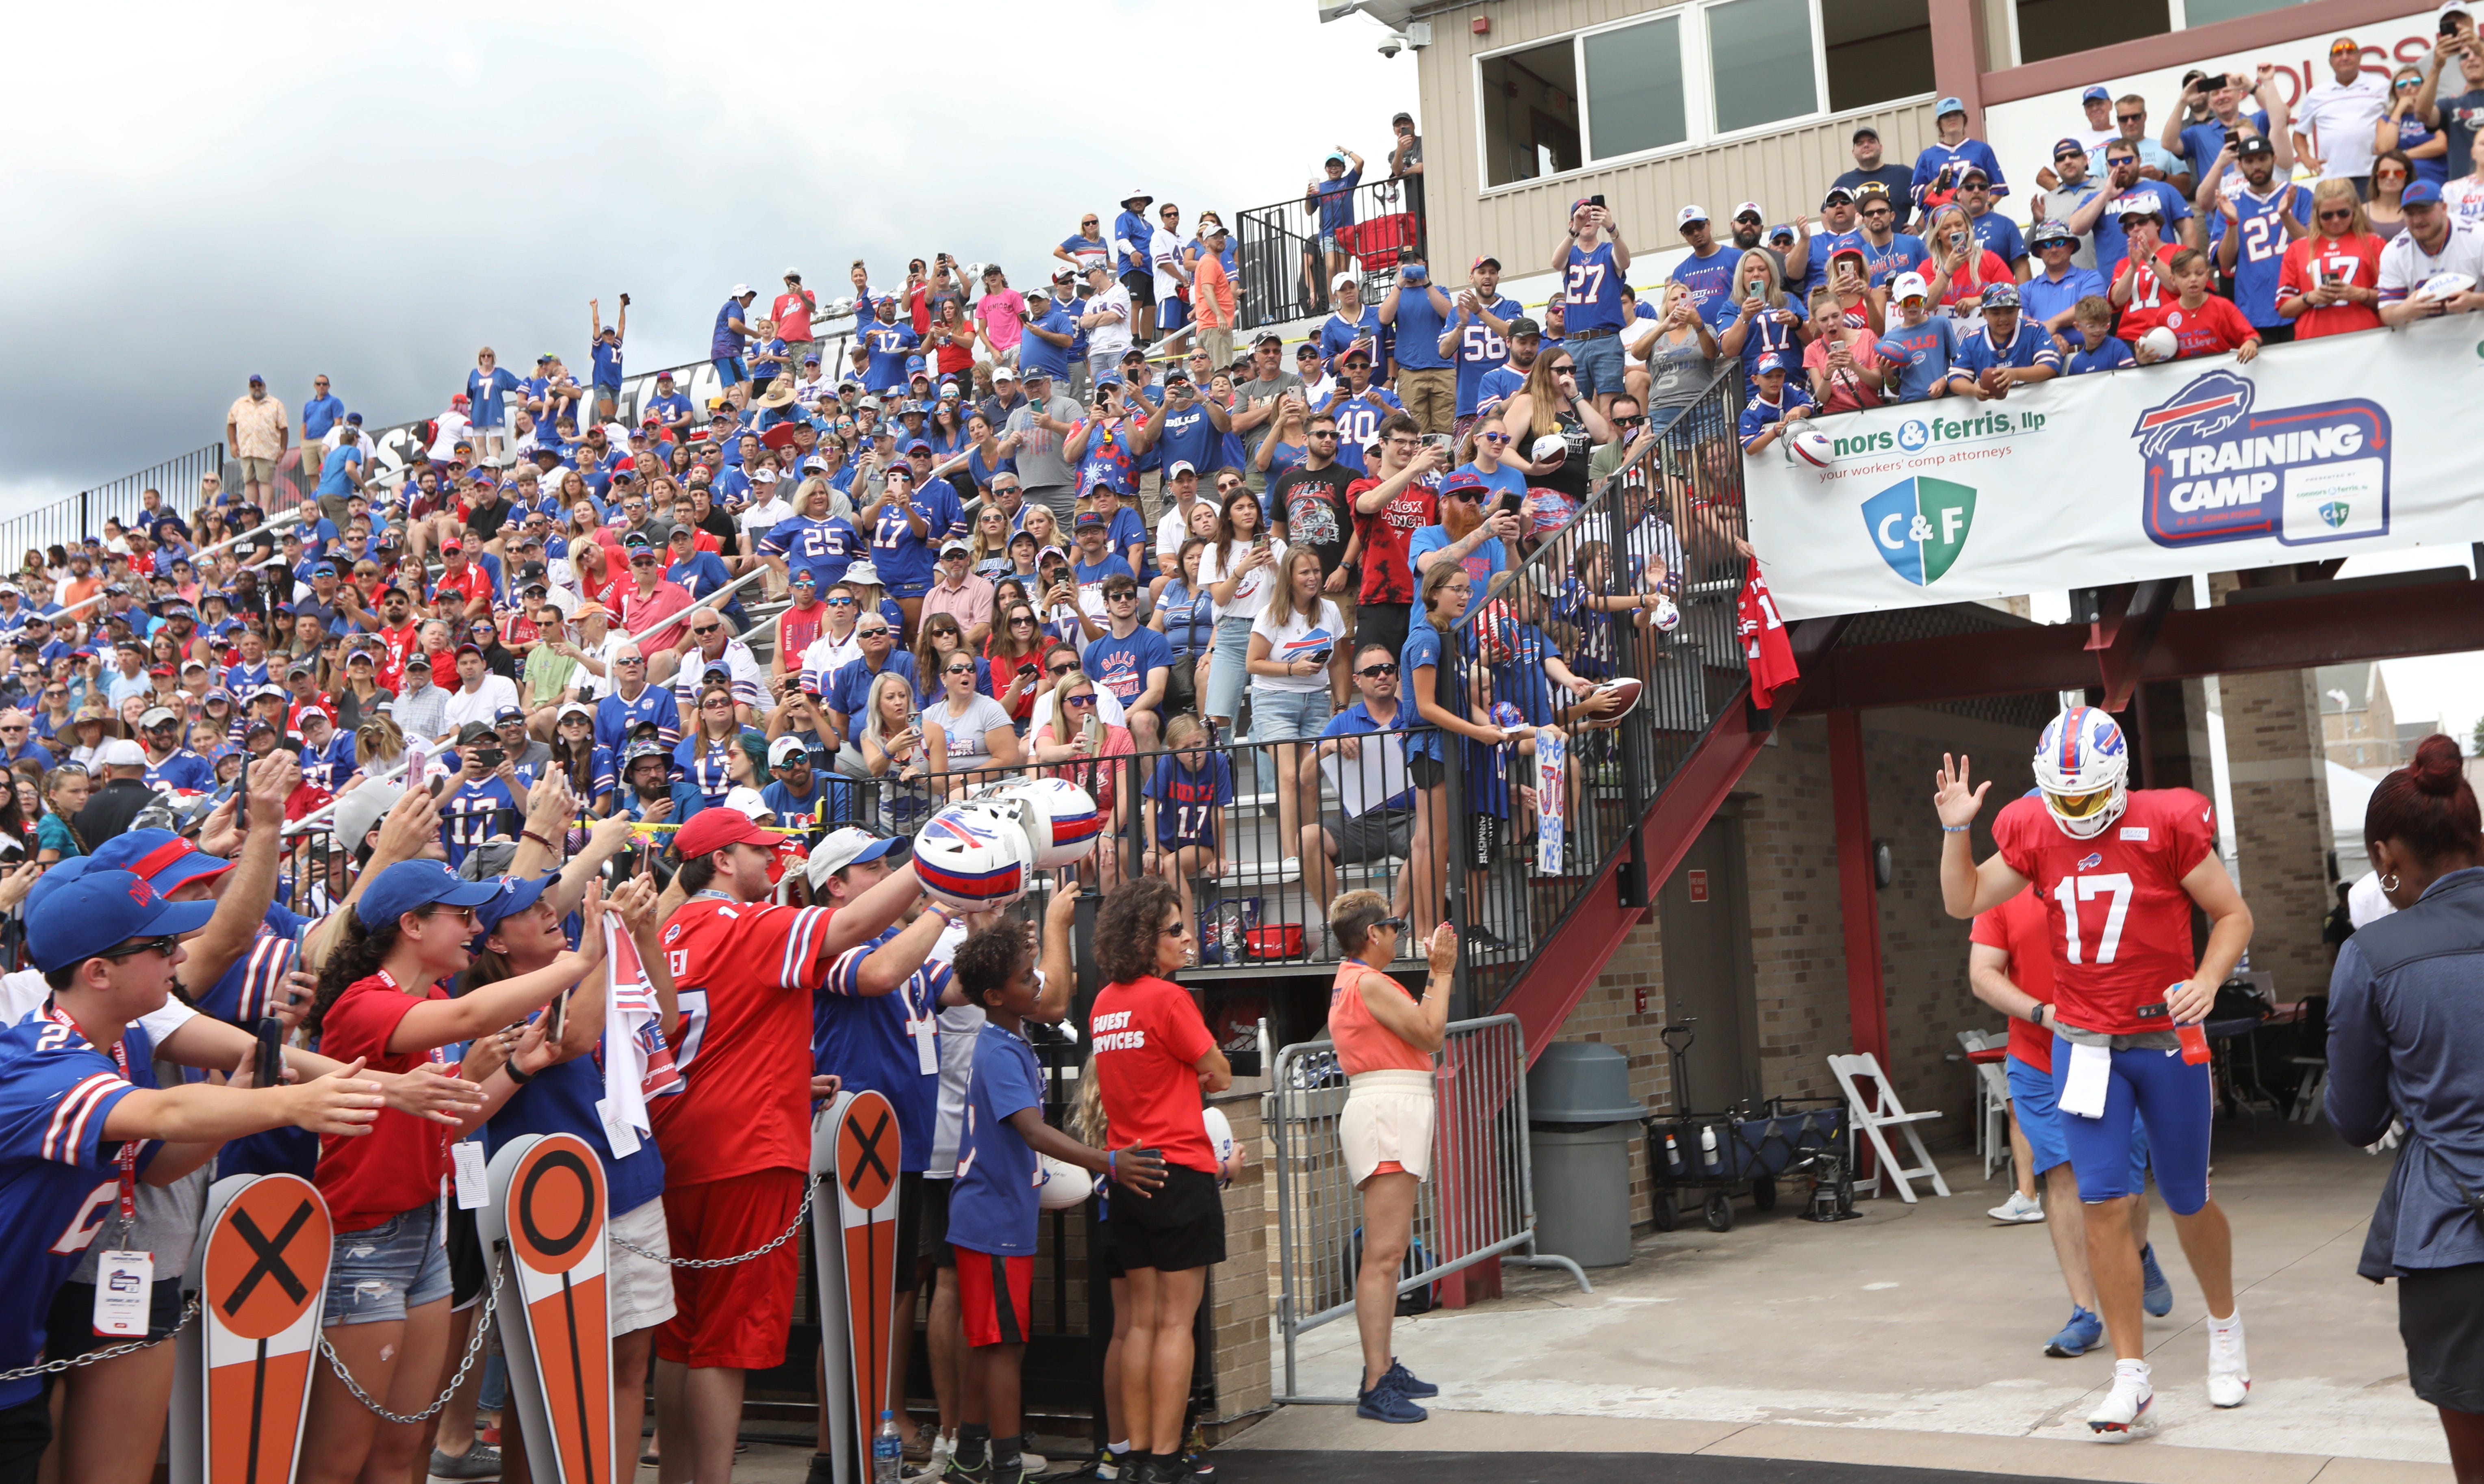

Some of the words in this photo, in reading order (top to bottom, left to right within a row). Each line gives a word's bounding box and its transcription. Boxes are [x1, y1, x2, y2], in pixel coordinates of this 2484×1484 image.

[2258, 206, 2274, 214] BILLS
[2244, 212, 2289, 262] 27
[1869, 254, 1909, 275] BILLS
[1566, 264, 1605, 304] 27
[2129, 271, 2161, 313] 17
[2306, 256, 2360, 308] 17
[2428, 276, 2460, 292] BILLS
[1890, 304, 1939, 318] TOAY
[879, 333, 900, 353] 17
[1464, 325, 1507, 362] 58
[1756, 312, 1790, 352] 17
[1902, 334, 1937, 351] ILLS
[1369, 335, 1380, 368] 1
[478, 378, 492, 400] 7
[1165, 414, 1200, 427] BILLS
[1337, 410, 1375, 445] 40
[1900, 420, 1925, 450] &
[1931, 410, 2015, 442] ferris,
[2022, 411, 2046, 432] llp
[1566, 438, 1584, 447] BILLS
[2168, 423, 2363, 479] TRAINING
[1820, 469, 1848, 484] your
[1851, 459, 1905, 475] workers'
[1908, 454, 1945, 469] comp
[1949, 445, 2012, 462] attorneys
[2169, 472, 2278, 514] CAMP
[2296, 489, 2327, 499] connors
[2187, 516, 2200, 525] ST.
[2202, 513, 2228, 524] JOHN
[2229, 509, 2262, 521] FISHER
[803, 527, 844, 557] 25
[873, 518, 908, 548] 17
[977, 557, 1013, 572] BUFFALO
[1101, 650, 1136, 671] BILLS
[1109, 680, 1141, 698] OTBALL
[693, 755, 730, 795] 17
[451, 797, 498, 844] 17
[783, 812, 795, 837] I
[1177, 804, 1207, 838] 17
[711, 891, 729, 899] BILLS
[2054, 872, 2134, 964] 17
[377, 970, 397, 988] BILLS
[53, 1009, 75, 1027] BILLS
[1093, 1011, 1132, 1033] GUEST
[677, 987, 708, 1094] 7
[1092, 1031, 1145, 1056] ERVICES
[113, 1041, 126, 1067] BILLS
